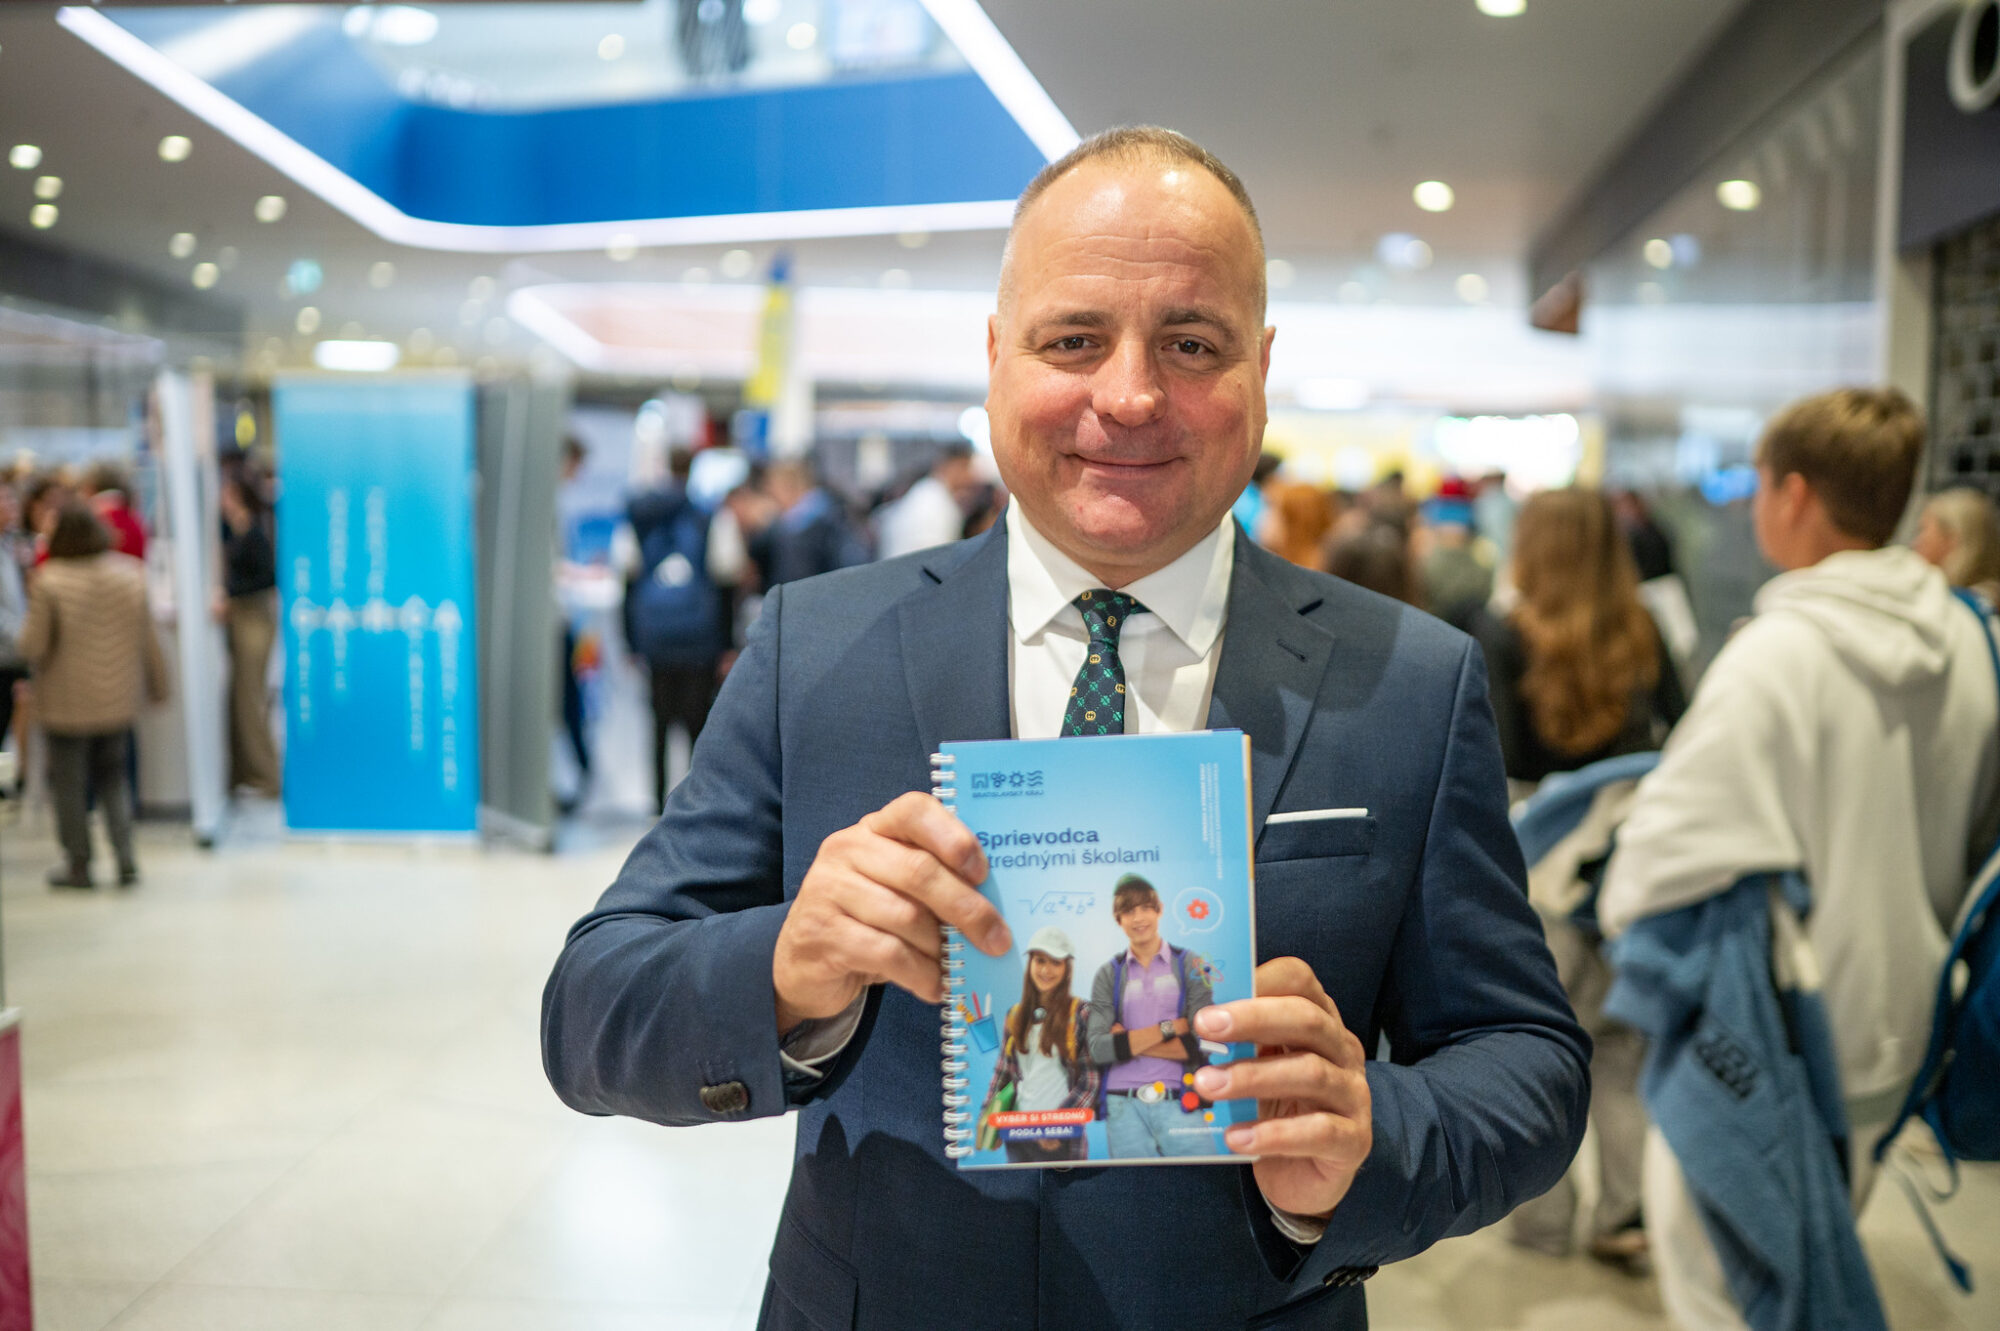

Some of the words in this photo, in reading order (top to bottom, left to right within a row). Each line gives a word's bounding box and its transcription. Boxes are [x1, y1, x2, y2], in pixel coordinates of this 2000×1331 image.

[976, 827, 1100, 850] Sprievodca
[986, 849, 1076, 870] trednými
[1081, 845, 1160, 865] školami
